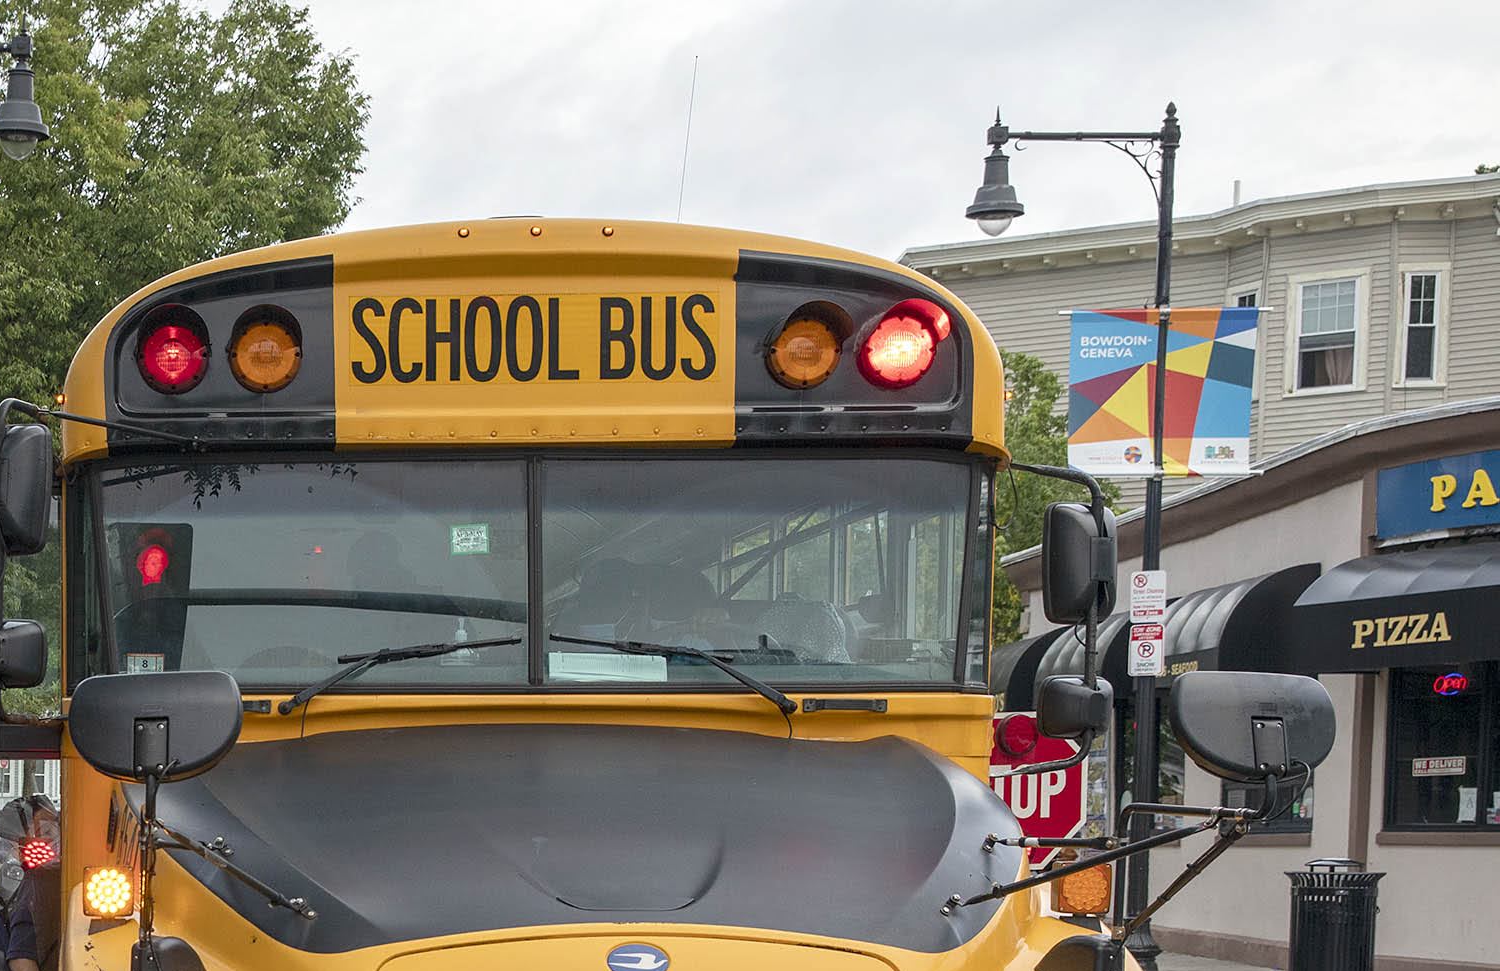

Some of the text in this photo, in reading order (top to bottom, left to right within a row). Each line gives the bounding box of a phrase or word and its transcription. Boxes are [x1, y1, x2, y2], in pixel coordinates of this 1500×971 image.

[351, 293, 717, 384] SCHOOL BUS
[1080, 335, 1152, 347] BOWDOIN-
[1080, 347, 1133, 358] GENEVA
[1351, 612, 1452, 649] PIZZA
[1433, 674, 1468, 694] Open
[1415, 759, 1463, 769] WE DELIVER
[990, 764, 1067, 819] TOP
